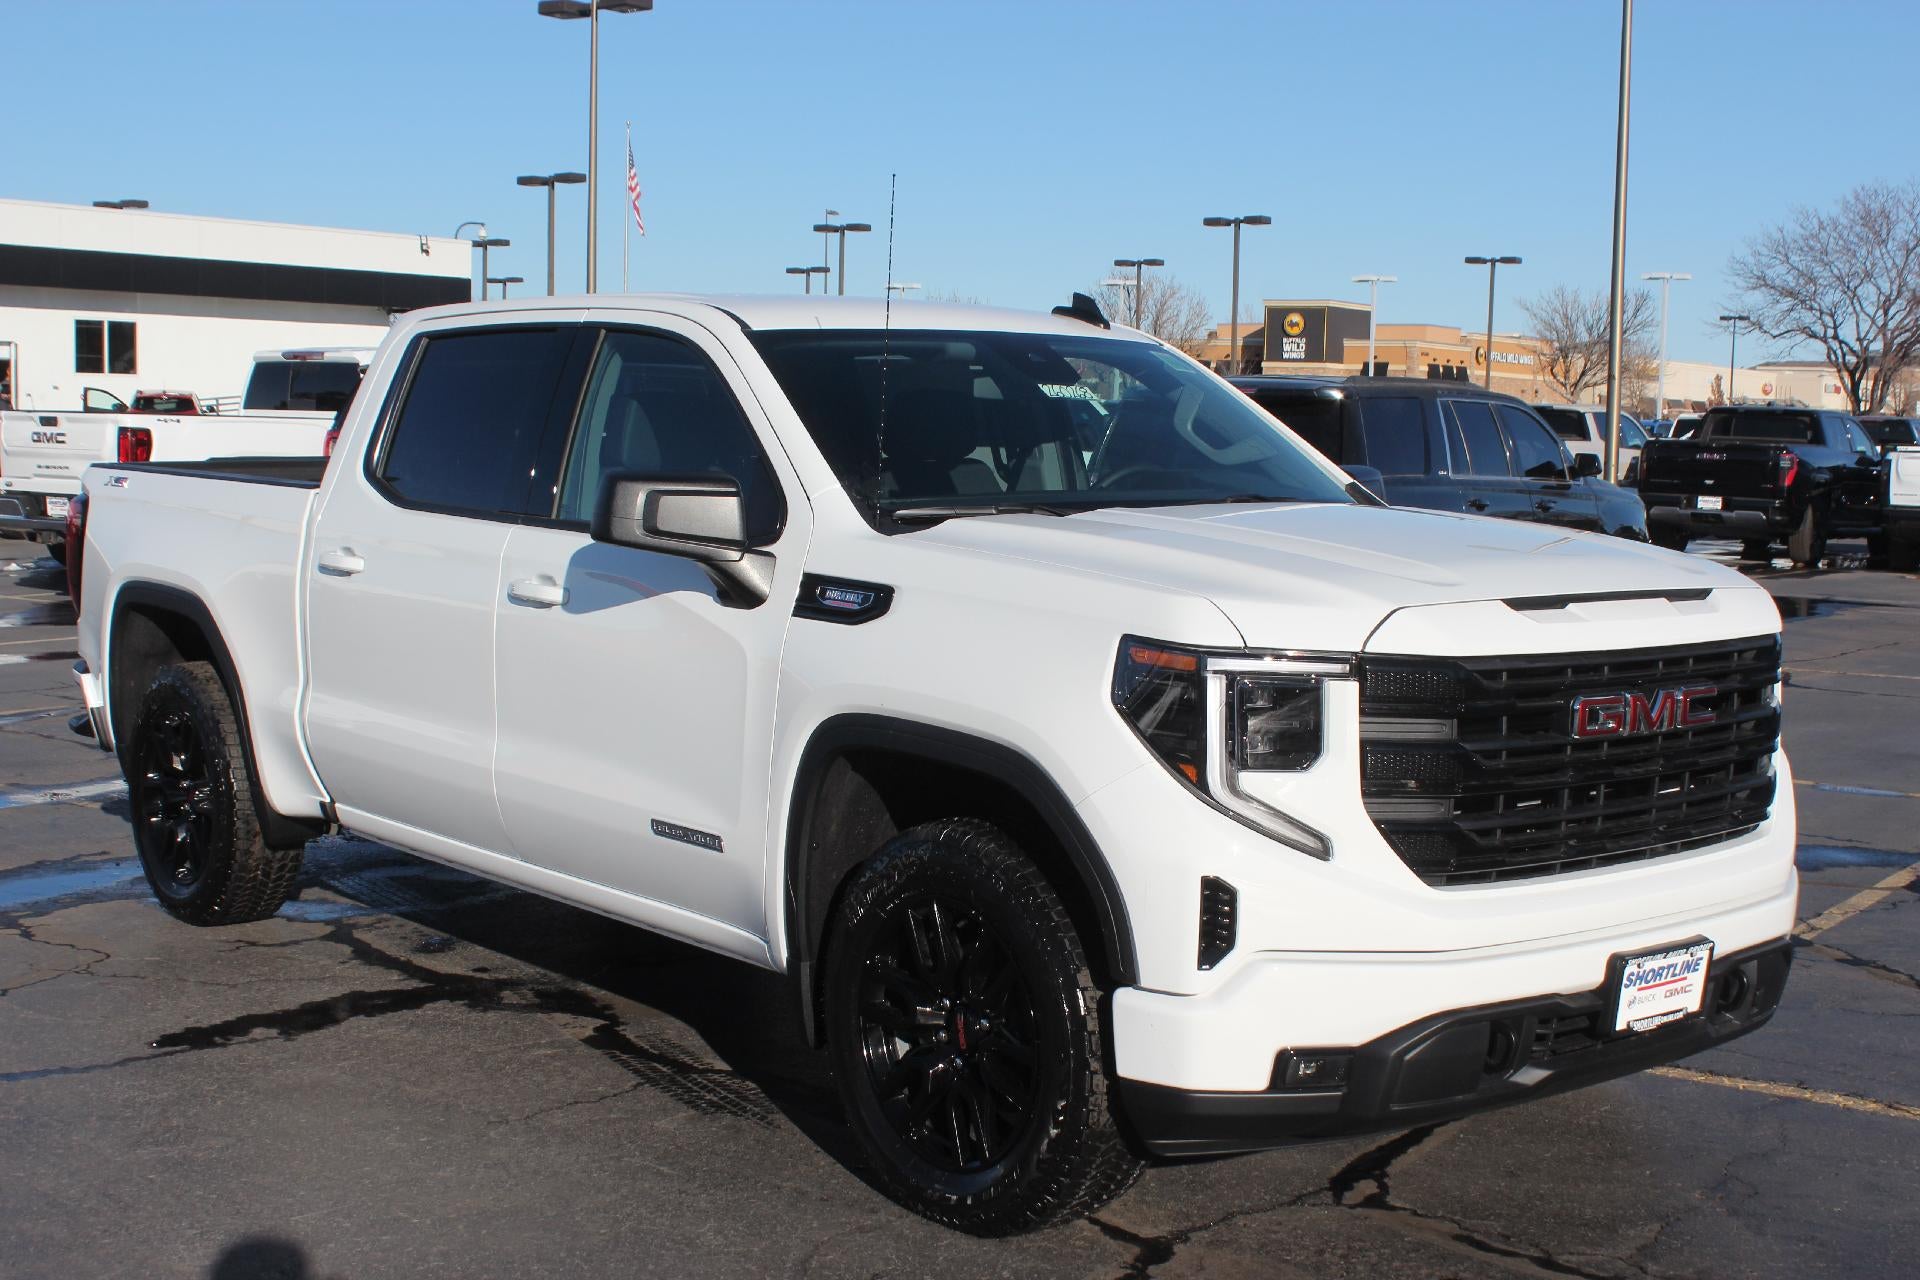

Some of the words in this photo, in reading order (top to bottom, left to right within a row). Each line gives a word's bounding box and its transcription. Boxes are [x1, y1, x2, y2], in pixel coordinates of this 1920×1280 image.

[1282, 352, 1305, 360] WINGS
[1283, 344, 1306, 352] WILD
[32, 431, 67, 444] GMC
[1569, 686, 1718, 740] GMC
[1624, 957, 1703, 989] SHORTLINE
[1637, 993, 1657, 1005] BUICK
[1663, 984, 1694, 999] GMC
